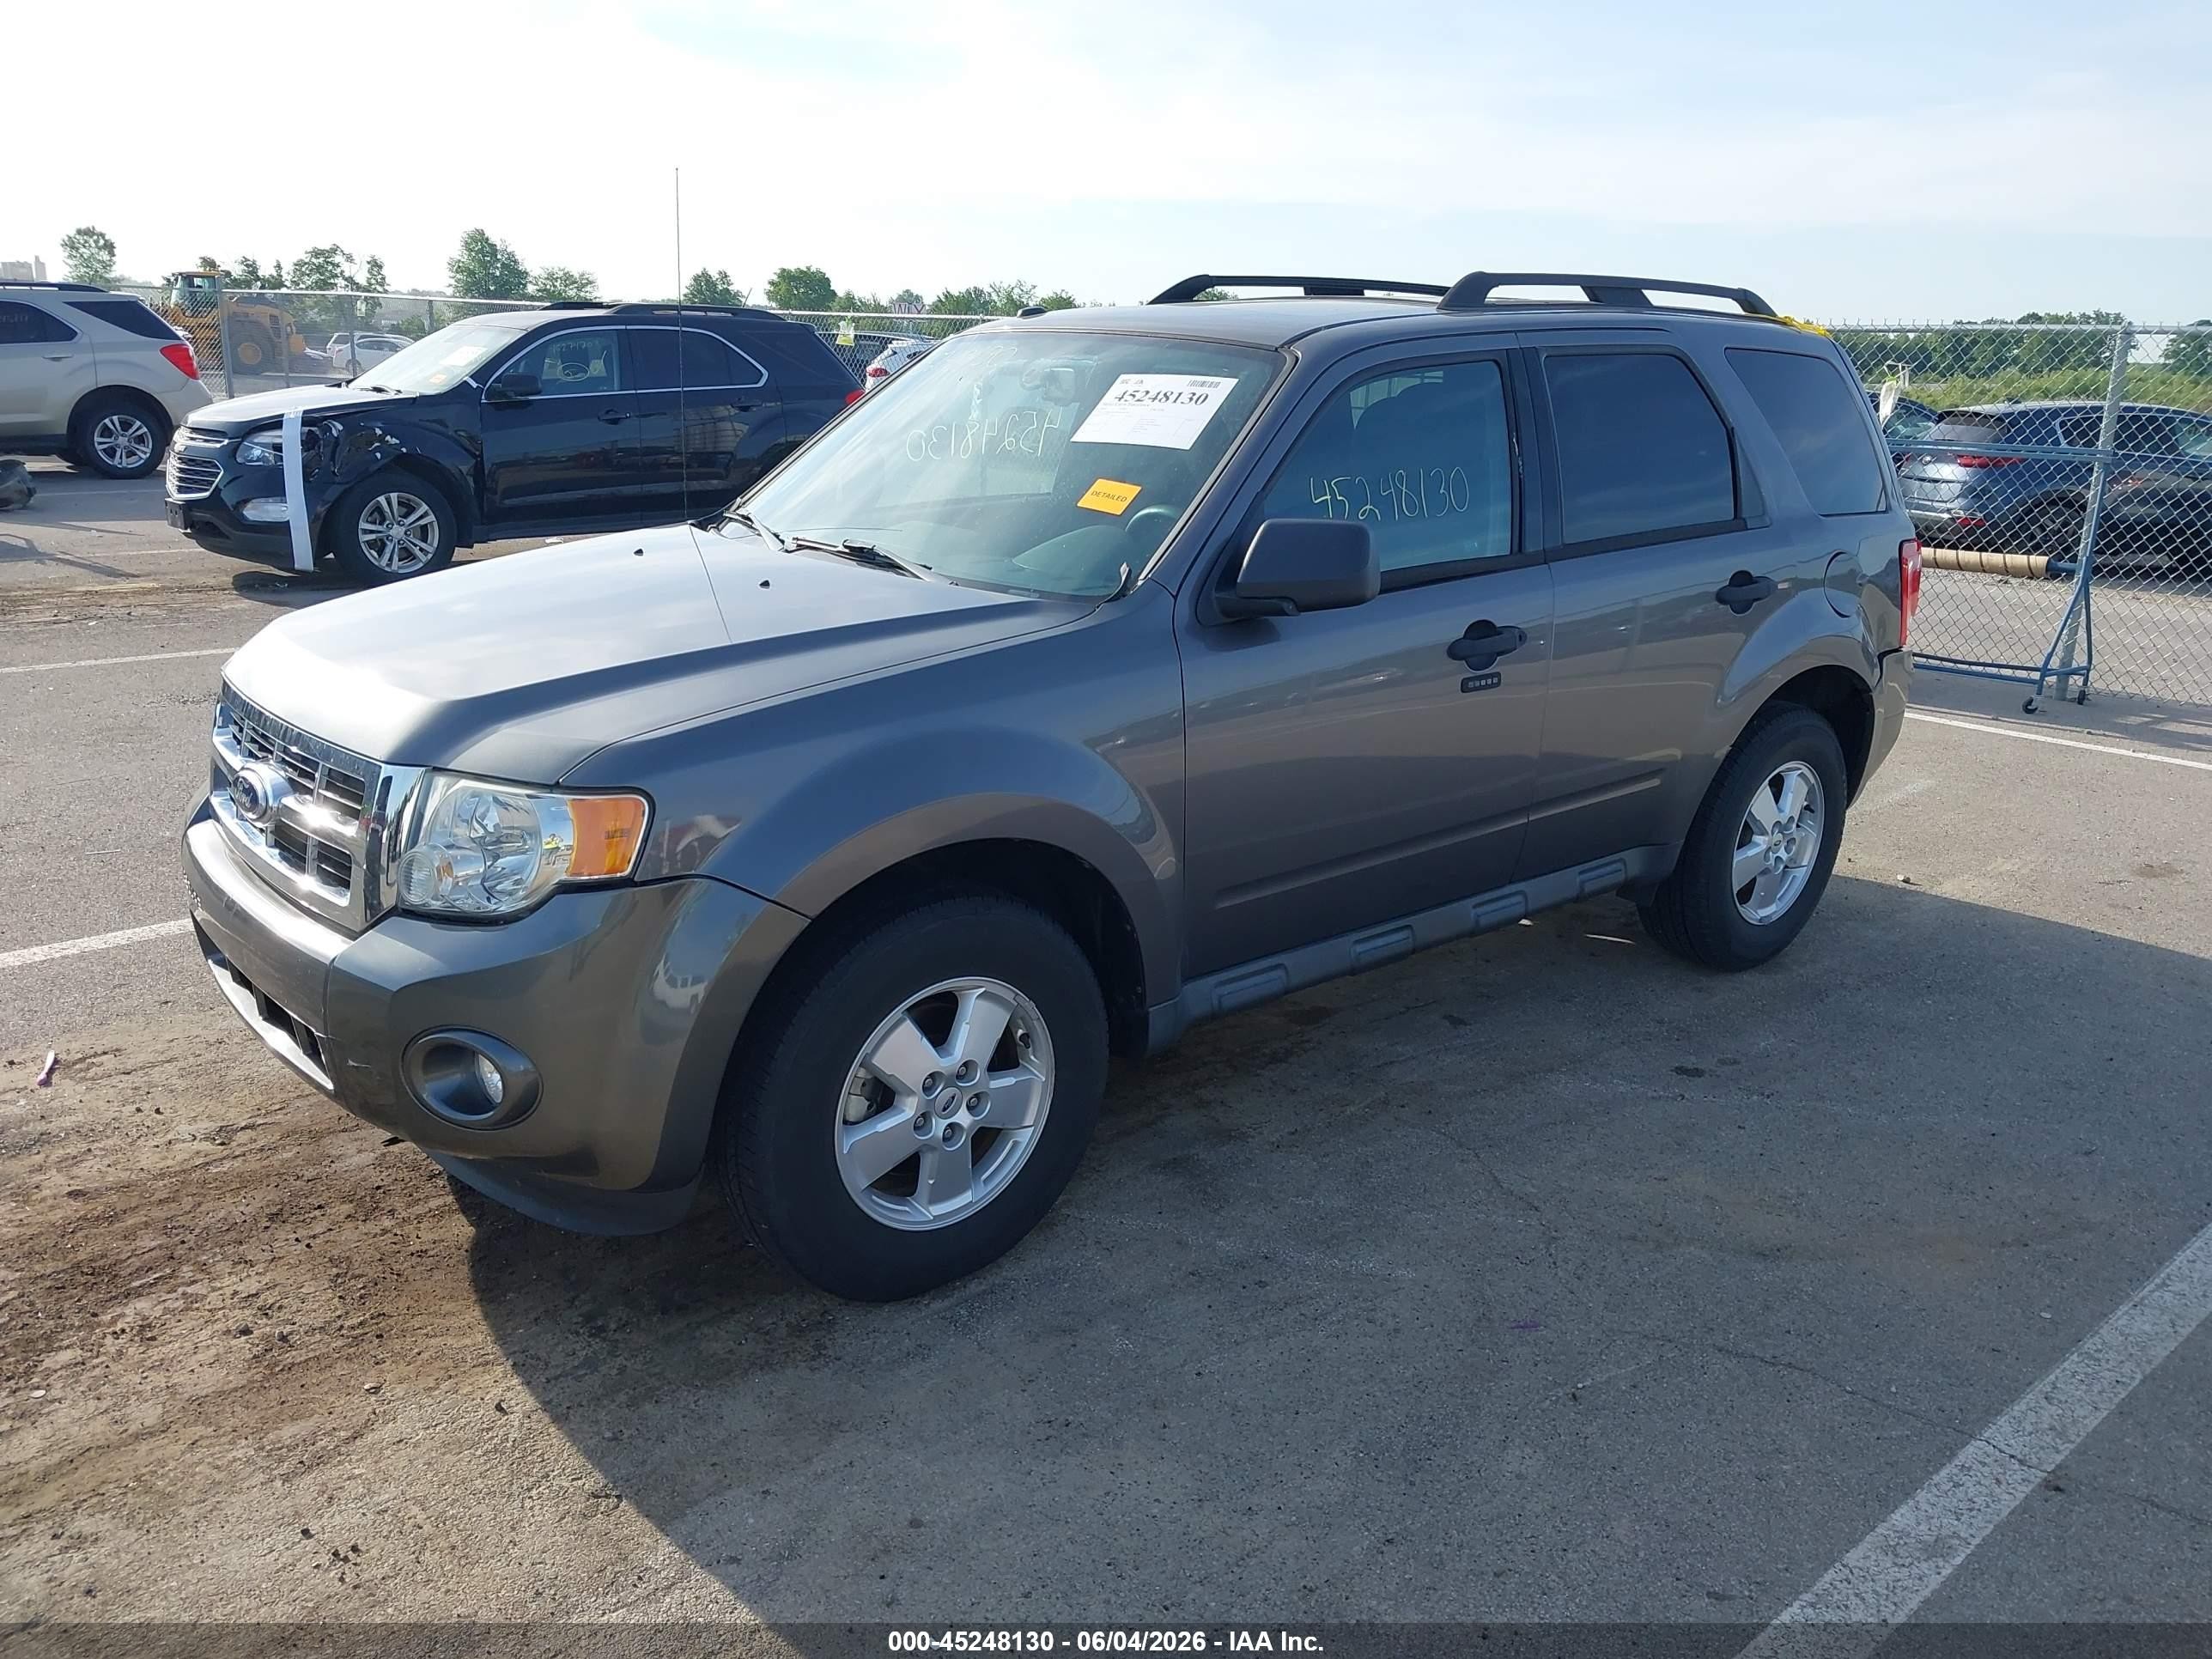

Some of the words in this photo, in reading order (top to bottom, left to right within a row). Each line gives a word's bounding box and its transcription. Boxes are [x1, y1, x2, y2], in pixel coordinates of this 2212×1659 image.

[1115, 389, 1209, 406] 45248130
[1091, 490, 1127, 501] DETAILED
[1310, 466, 1469, 521] 45248130
[234, 777, 254, 808] Ford
